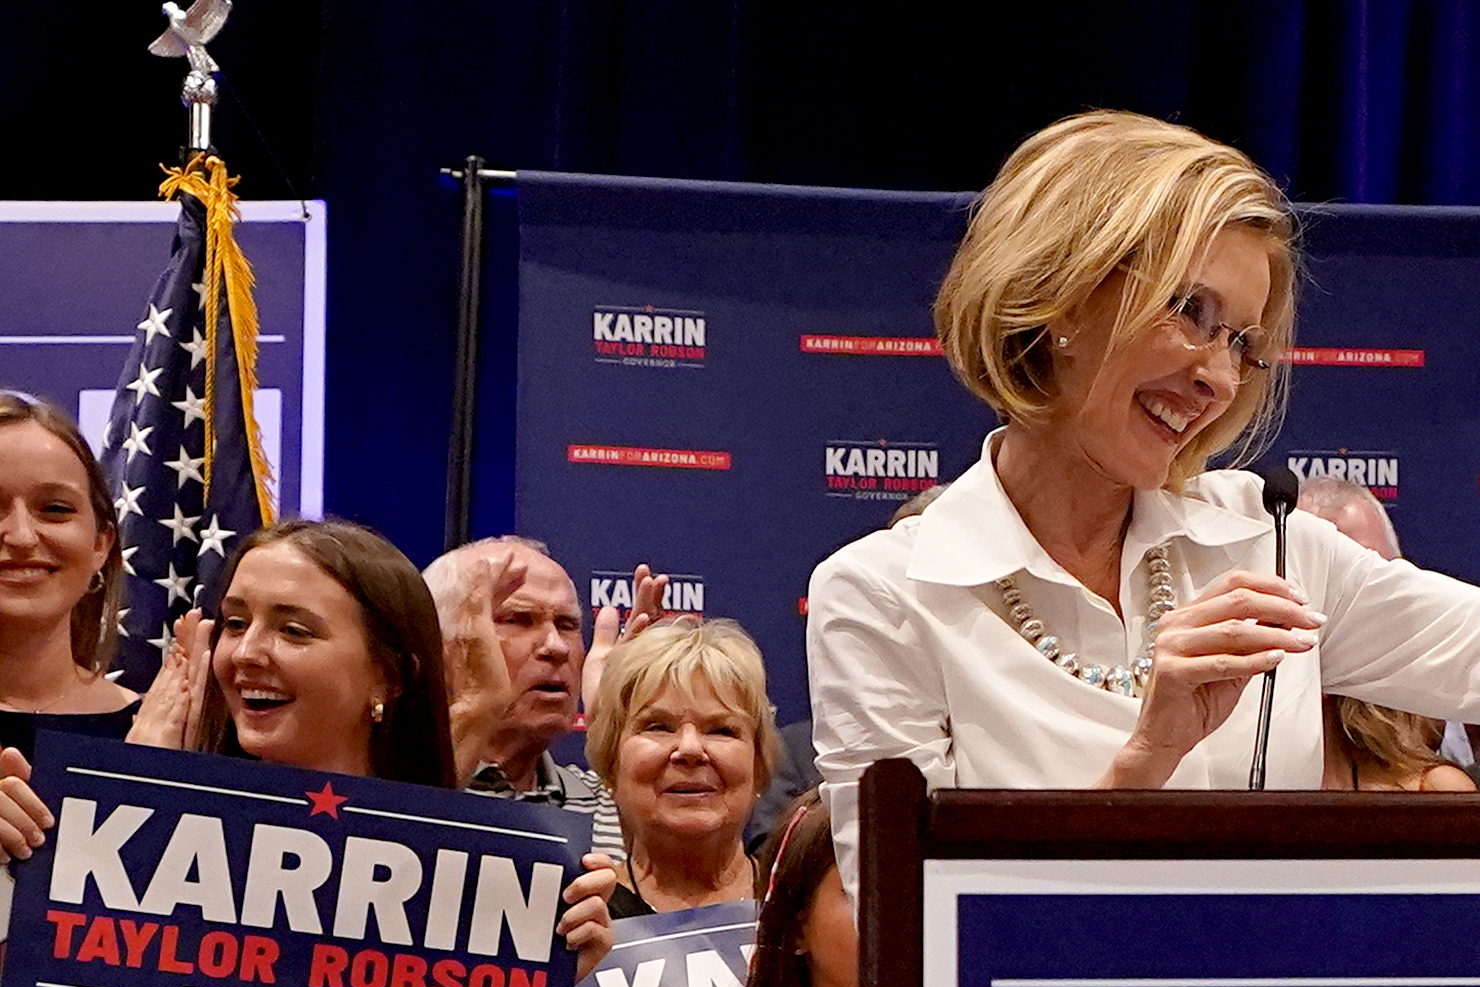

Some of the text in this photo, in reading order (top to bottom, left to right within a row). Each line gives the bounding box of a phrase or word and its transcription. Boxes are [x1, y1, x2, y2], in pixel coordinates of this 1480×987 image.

[594, 312, 706, 347] KARRIN
[594, 341, 705, 359] TAYLOR ROBSON
[826, 447, 938, 478] KARRIN
[827, 475, 878, 490] TAYLOR
[49, 797, 564, 963] KARRIN
[47, 910, 279, 984] TAYLOR
